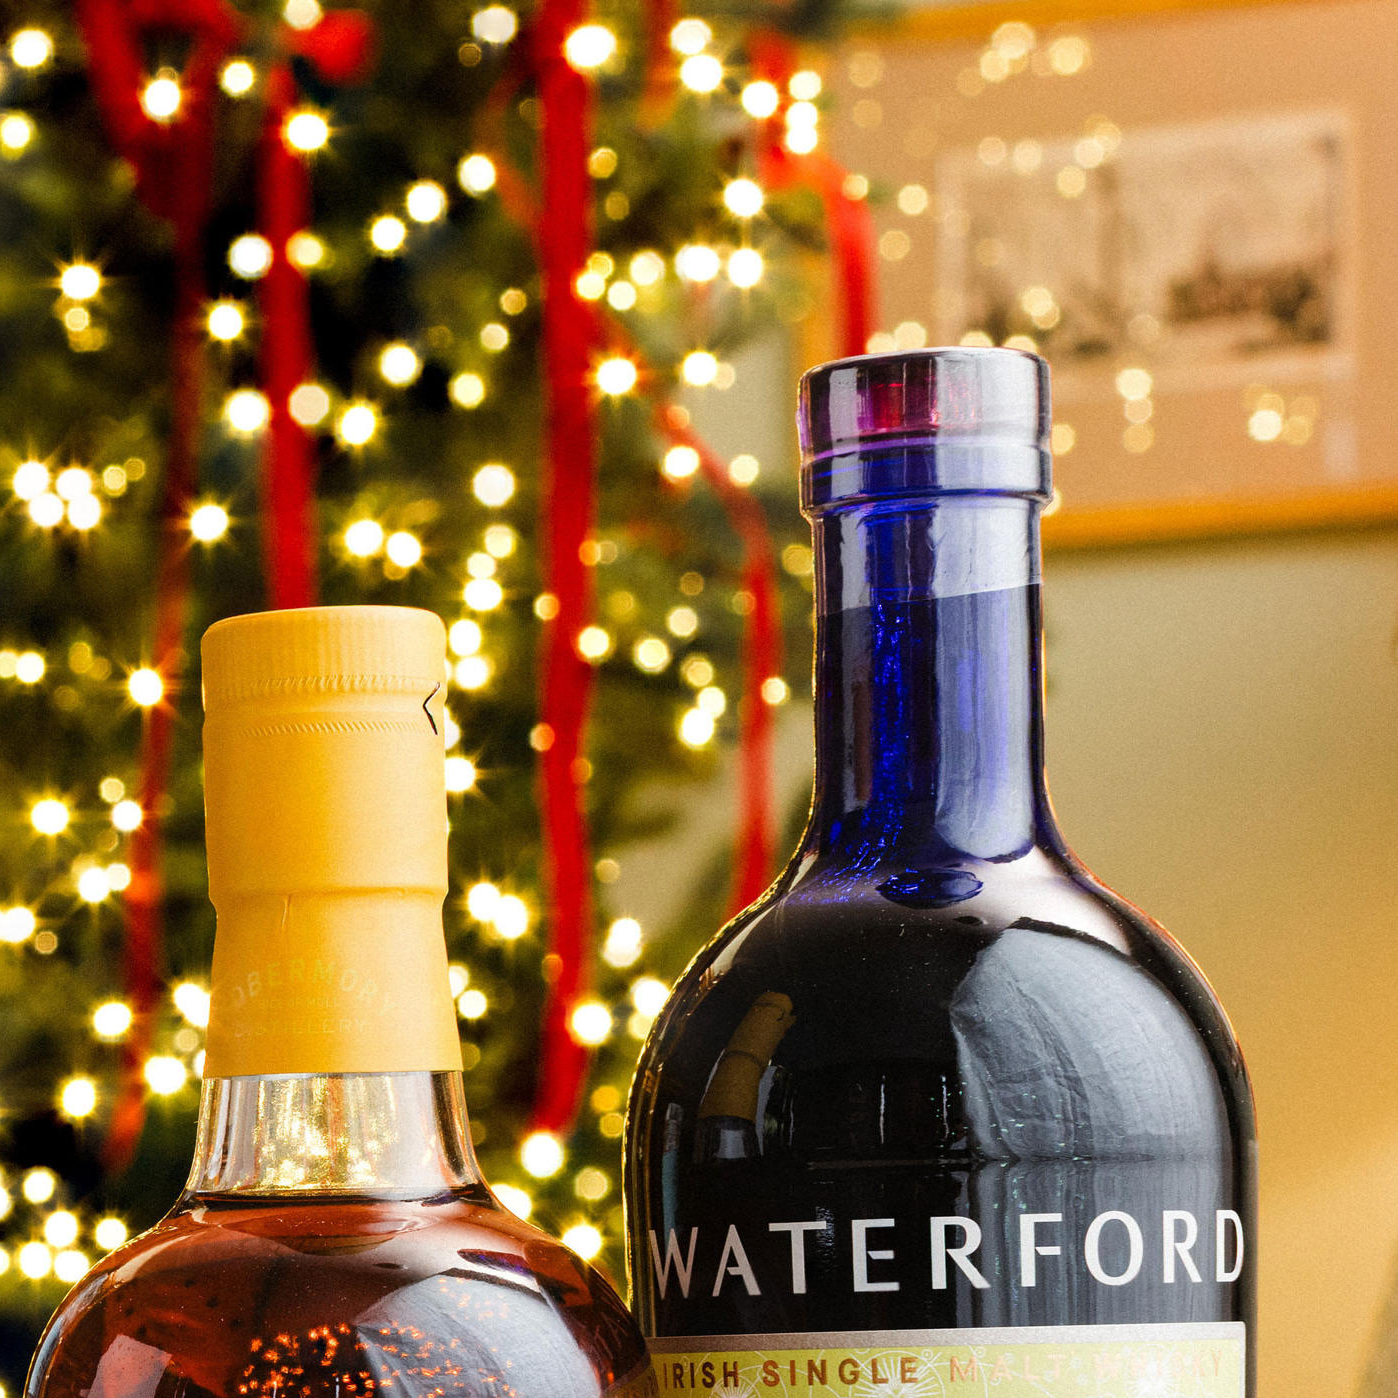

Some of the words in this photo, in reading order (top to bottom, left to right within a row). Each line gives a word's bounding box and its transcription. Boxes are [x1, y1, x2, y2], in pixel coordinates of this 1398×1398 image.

[648, 1209, 1245, 1300] WATERFORD
[662, 1360, 739, 1390] IRISH
[762, 1357, 919, 1388] SINGLE
[949, 1353, 1066, 1383] MALT
